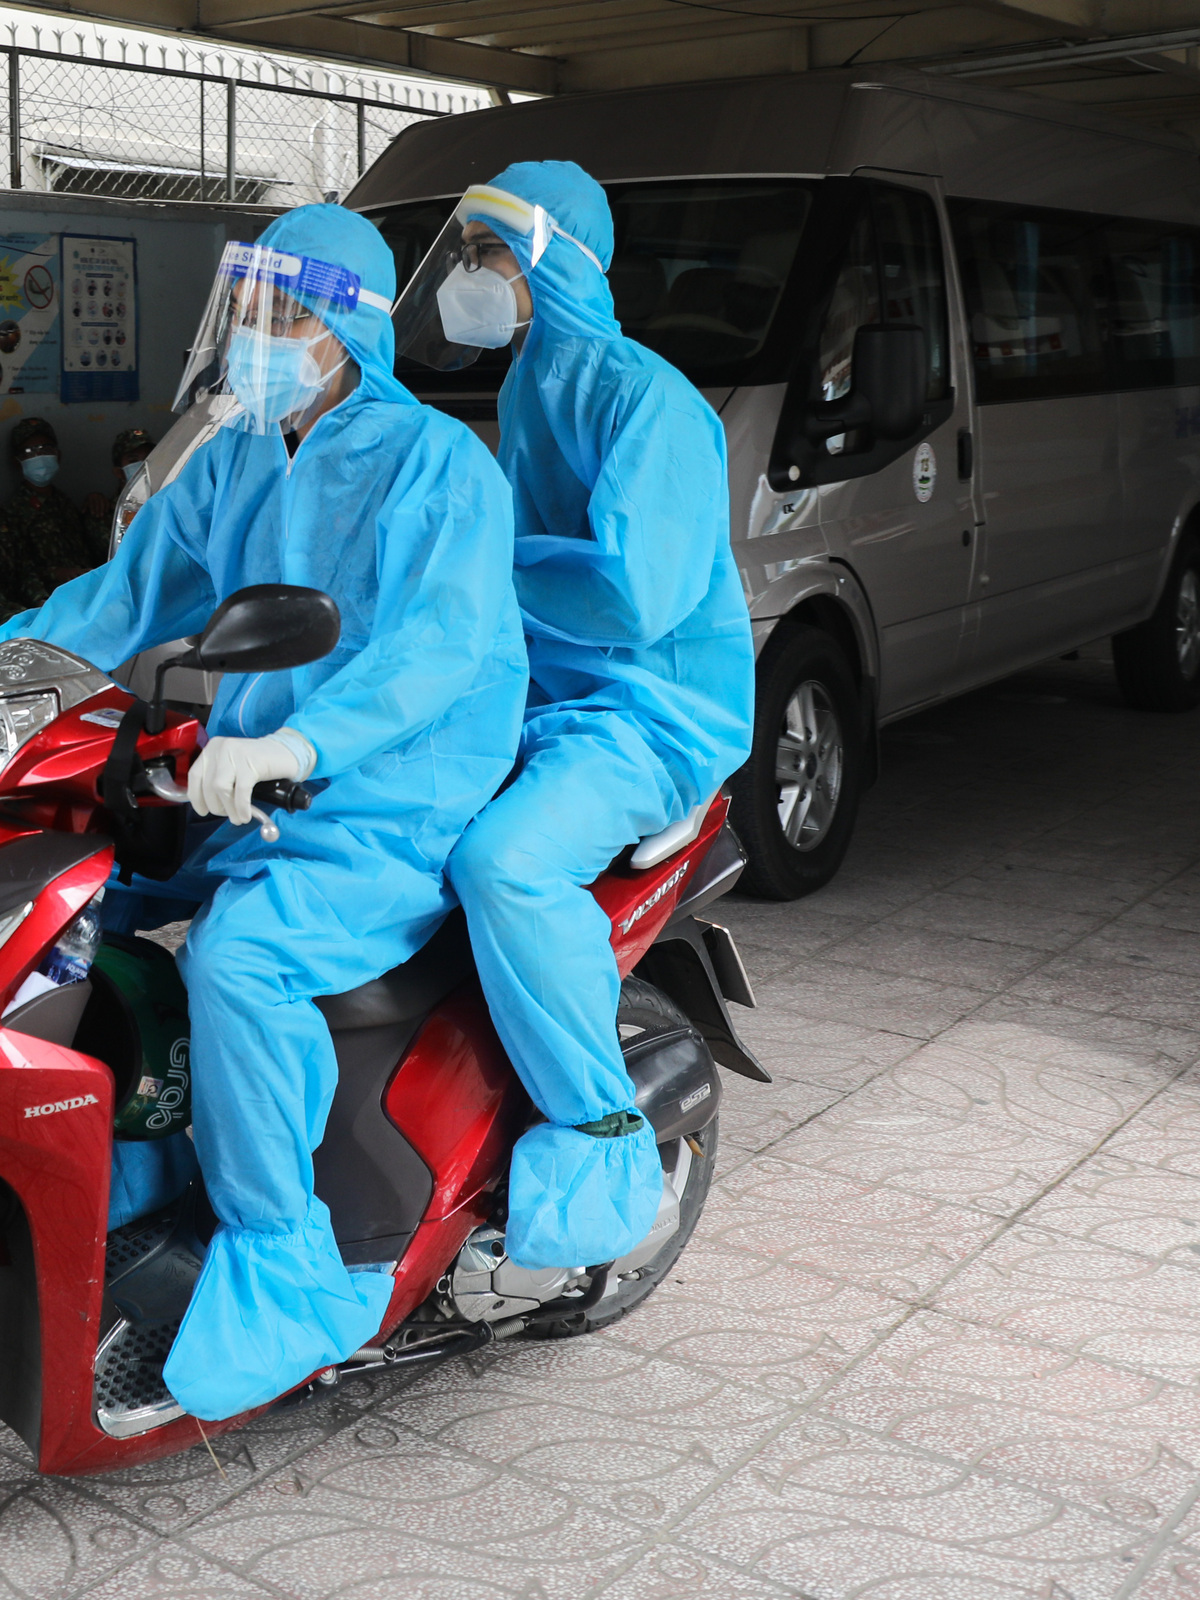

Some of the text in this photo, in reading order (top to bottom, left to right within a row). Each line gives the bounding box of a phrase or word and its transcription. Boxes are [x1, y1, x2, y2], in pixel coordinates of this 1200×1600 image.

[617, 859, 690, 936] VISION
[24, 1093, 99, 1119] HONDA
[145, 1036, 191, 1130] Grab
